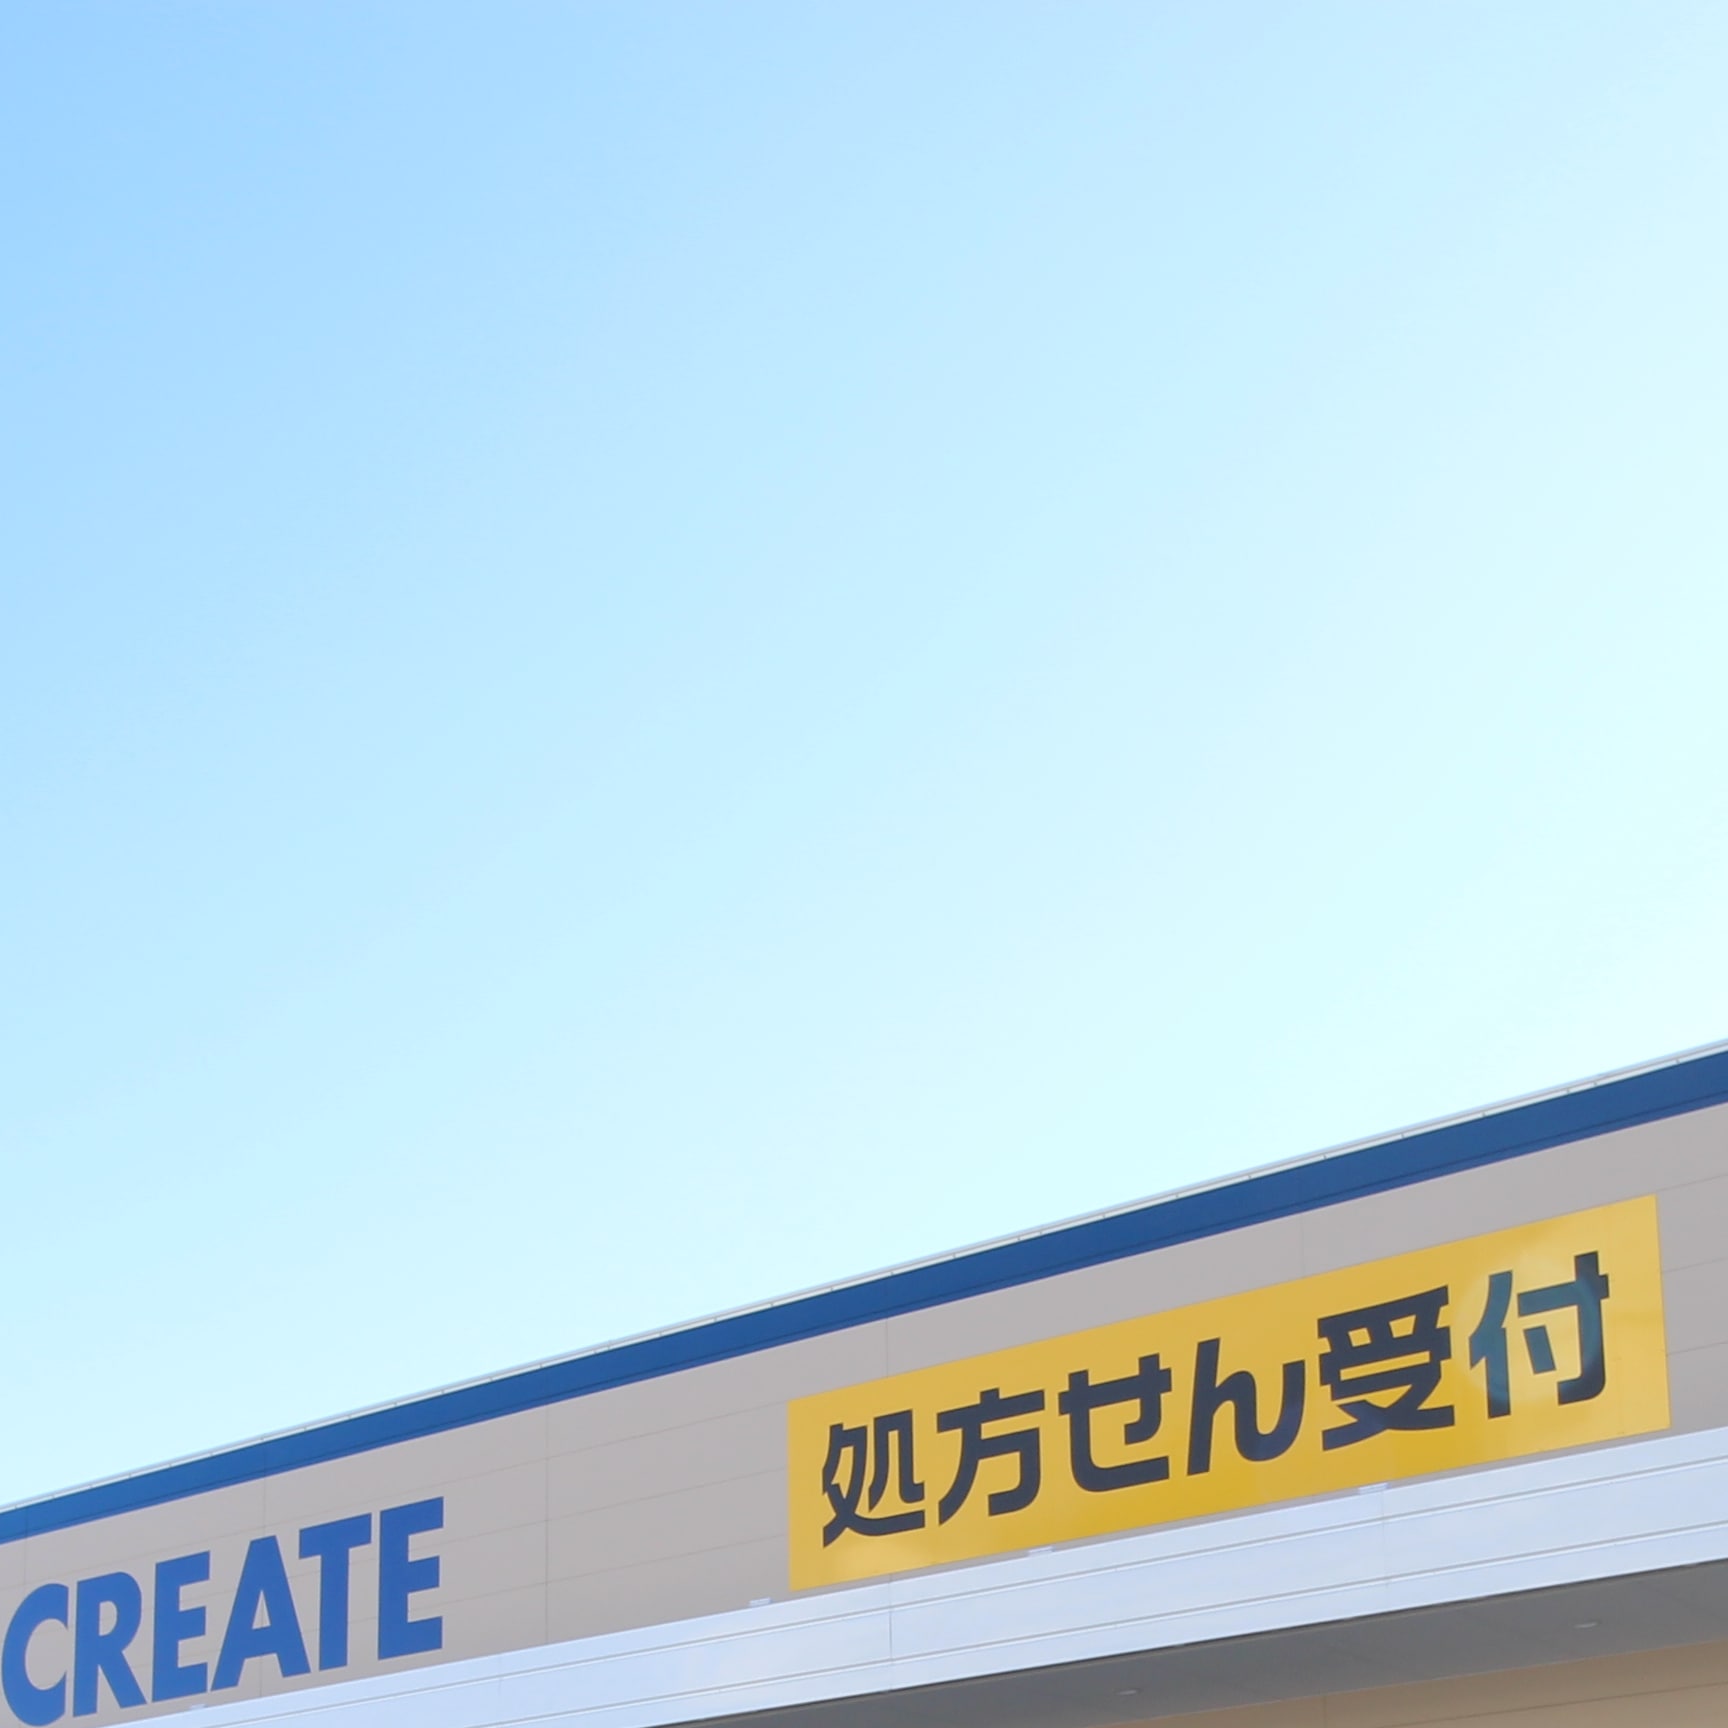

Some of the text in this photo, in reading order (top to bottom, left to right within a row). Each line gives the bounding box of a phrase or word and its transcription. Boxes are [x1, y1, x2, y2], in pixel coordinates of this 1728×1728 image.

[823, 1251, 1609, 1547] 処方せん受付
[1, 1496, 444, 1727] CREATE
